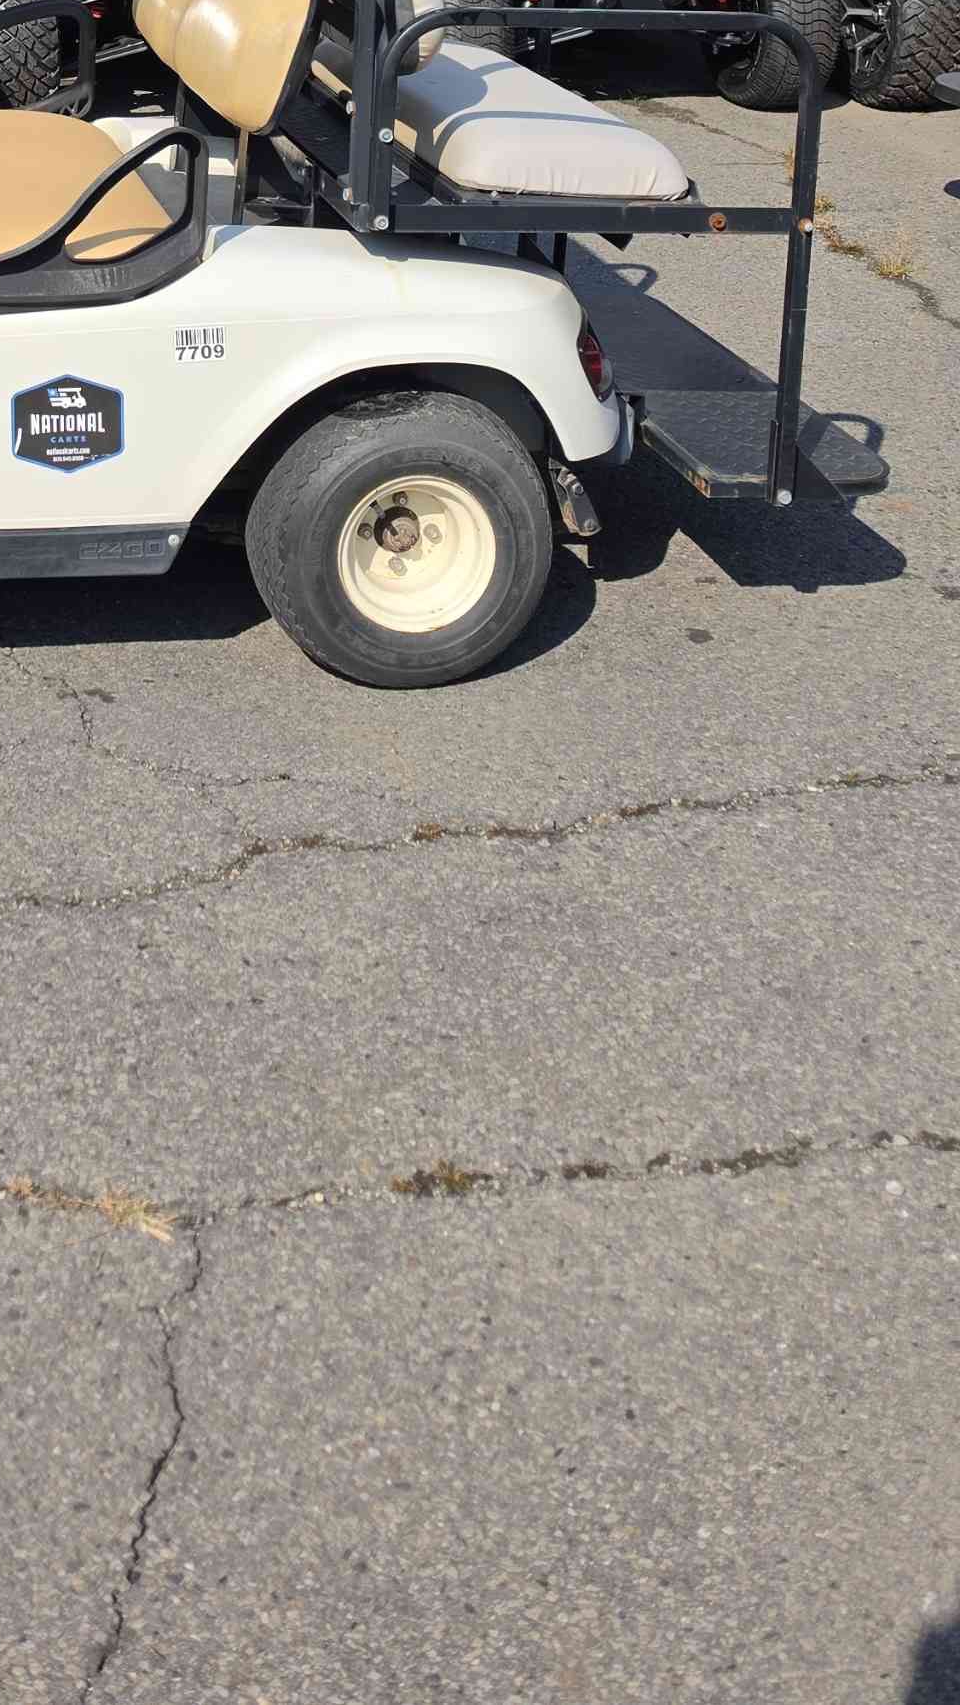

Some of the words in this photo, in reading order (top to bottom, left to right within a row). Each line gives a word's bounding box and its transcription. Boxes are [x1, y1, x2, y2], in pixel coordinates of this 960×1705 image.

[175, 344, 225, 361] 7709
[30, 412, 106, 436] NATIONAL
[50, 435, 87, 444] CARTS
